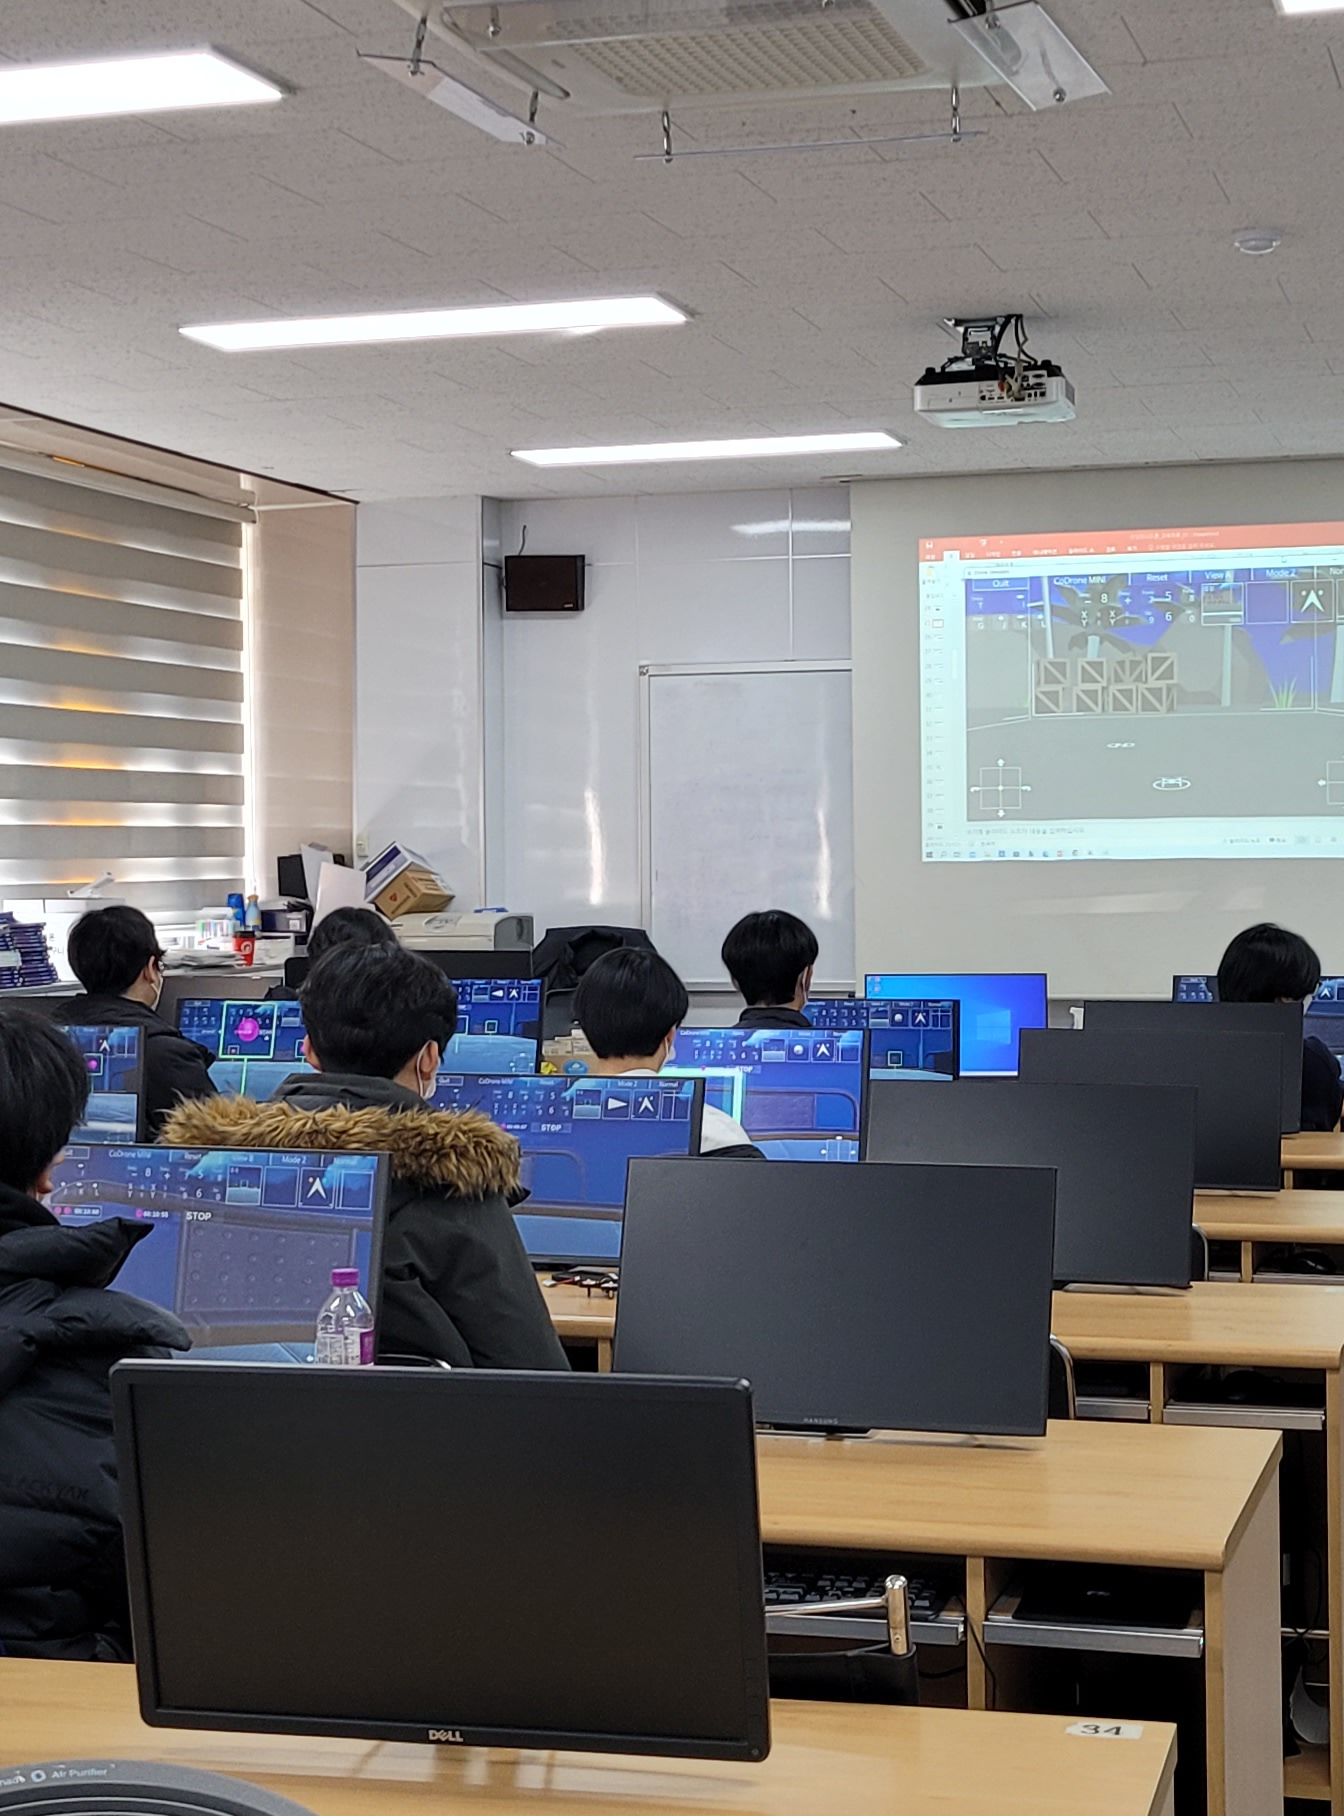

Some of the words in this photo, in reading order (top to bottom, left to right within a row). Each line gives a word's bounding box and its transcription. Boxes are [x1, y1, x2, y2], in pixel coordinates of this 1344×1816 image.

[1205, 570, 1224, 580] View
[1265, 568, 1288, 577] Mode
[992, 578, 1010, 588] Quit
[1053, 576, 1087, 586] CoDrone
[1146, 573, 1168, 583] Reset
[1100, 593, 1108, 604] 8
[1165, 611, 1173, 622] 6
[658, 1080, 679, 1088] Normal
[507, 1091, 514, 1100] 8
[548, 1106, 555, 1115] 6
[540, 1123, 562, 1132] STOP
[108, 1149, 136, 1158] CoDrone
[281, 1155, 302, 1164] Mode
[144, 1167, 152, 1177] 8
[196, 1188, 202, 1198] 6
[185, 1211, 212, 1221] STOP
[1081, 1724, 1121, 1736] 34
[428, 1729, 464, 1742] DELL
[51, 1770, 67, 1779] Air
[69, 1768, 108, 1778] Purifier
